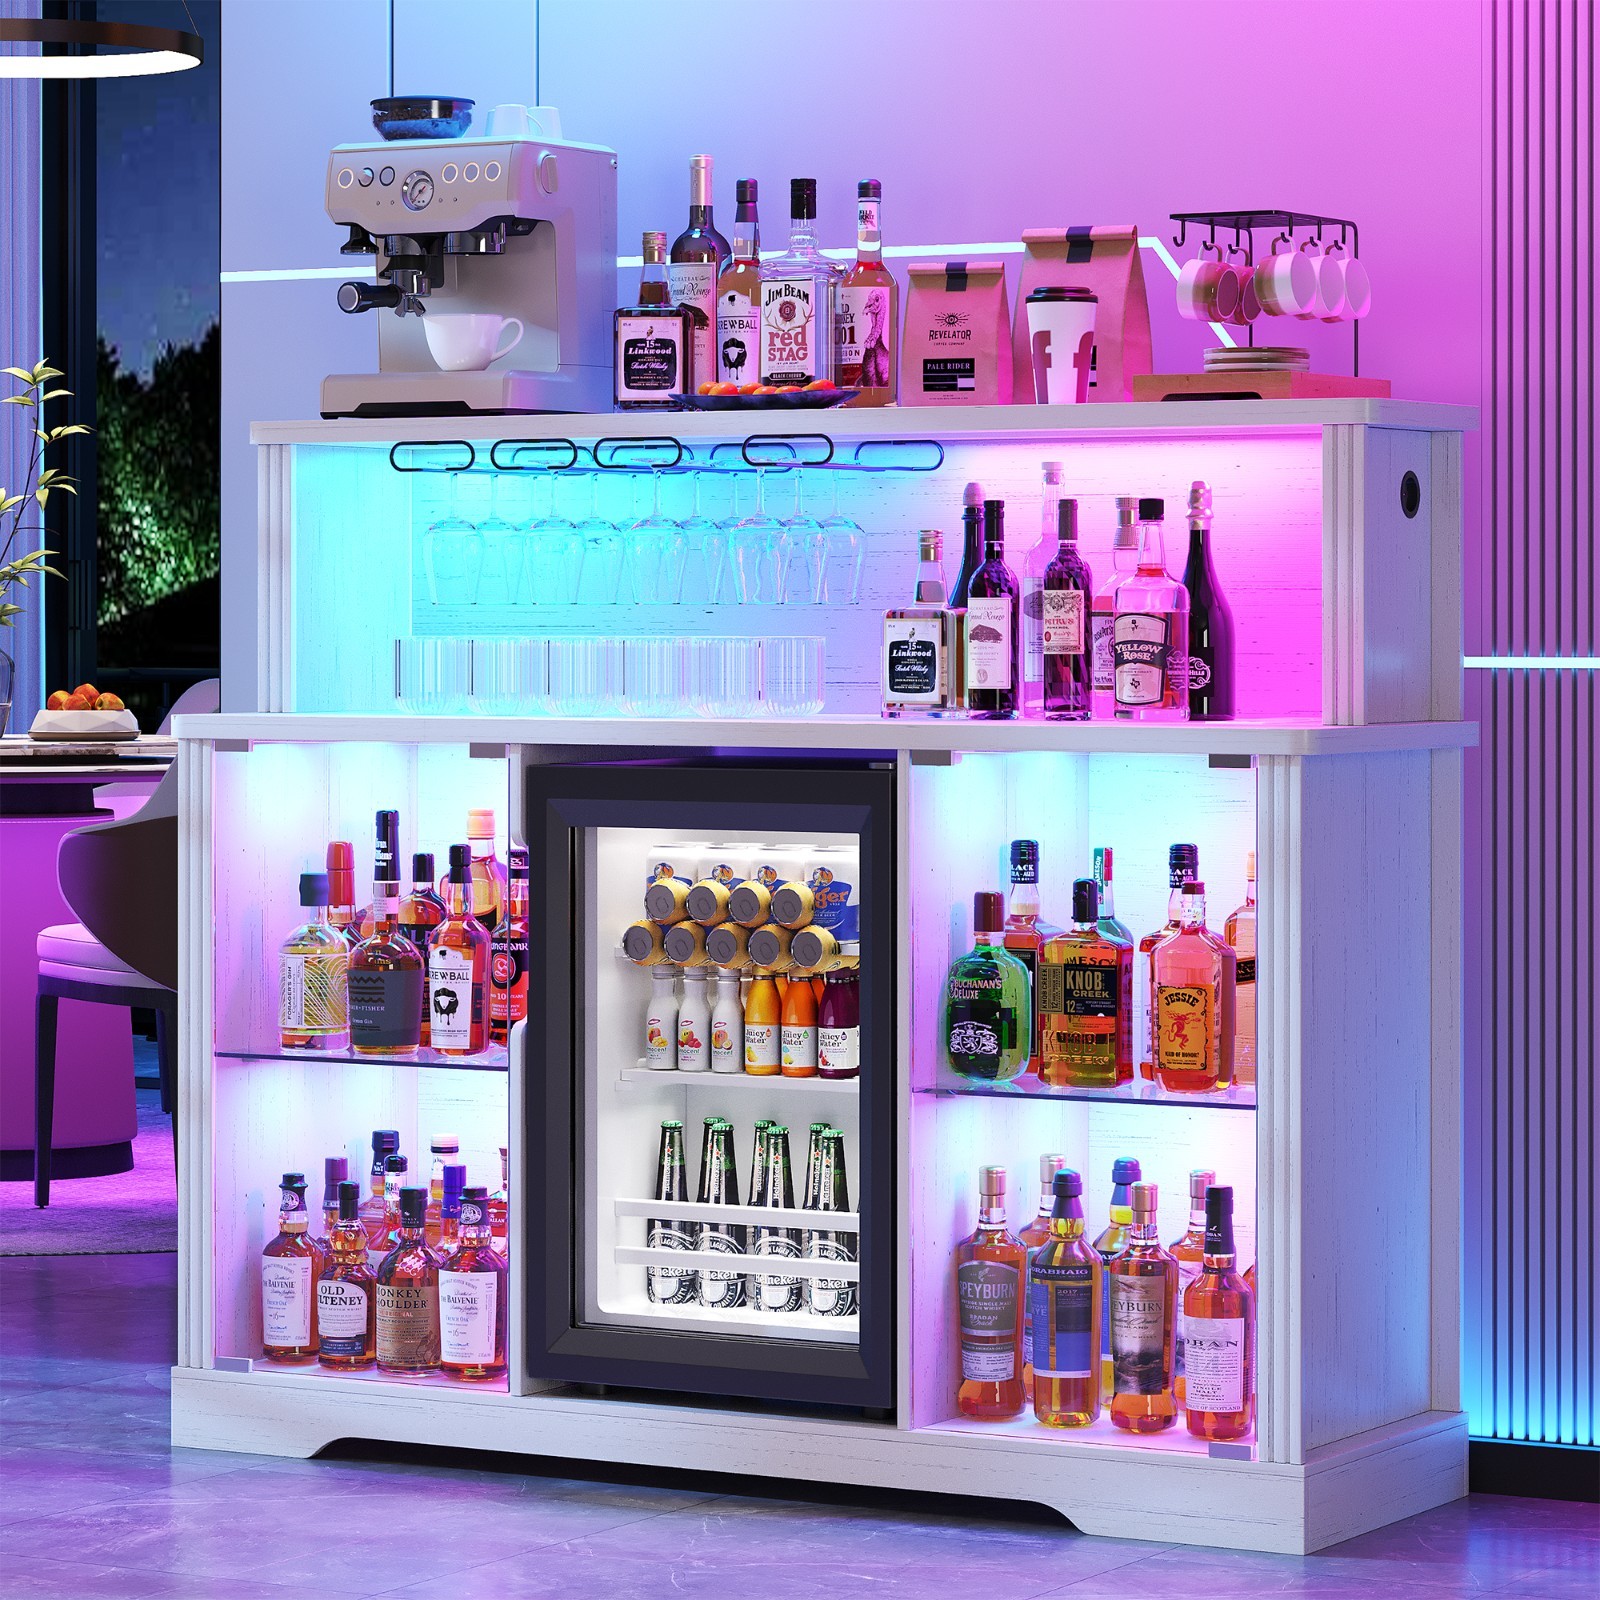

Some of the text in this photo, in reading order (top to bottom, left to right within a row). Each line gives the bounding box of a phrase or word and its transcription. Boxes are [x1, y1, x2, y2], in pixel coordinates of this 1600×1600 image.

[765, 283, 810, 307] JIM BEAM
[768, 324, 808, 347] red
[929, 330, 971, 341] REVELATOR
[646, 340, 655, 348] 15
[628, 347, 672, 355] Linkwood
[768, 347, 808, 362] STAG
[909, 642, 917, 650] 15
[1115, 643, 1163, 655] YELLOW
[891, 649, 932, 657] Linkwood
[1123, 651, 1151, 661] ROSE
[954, 978, 1002, 989] BUCHANAN'S
[1066, 970, 1102, 991] KNOB
[497, 992, 507, 1000] 10
[954, 988, 979, 999] DELUXE
[1073, 990, 1109, 998] CREEK
[1164, 992, 1199, 1007] JESSIE
[1066, 1000, 1076, 1013] 12
[745, 1029, 765, 1037] Juicy
[783, 1030, 803, 1039] Juicy
[820, 1032, 840, 1040] Juicy
[745, 1036, 767, 1044] Water
[783, 1038, 803, 1046] Water
[1043, 1030, 1097, 1054] KNOB
[269, 1279, 295, 1288] BALVENIE
[321, 1285, 345, 1295] OLD
[447, 1295, 478, 1304] BALVENIE
